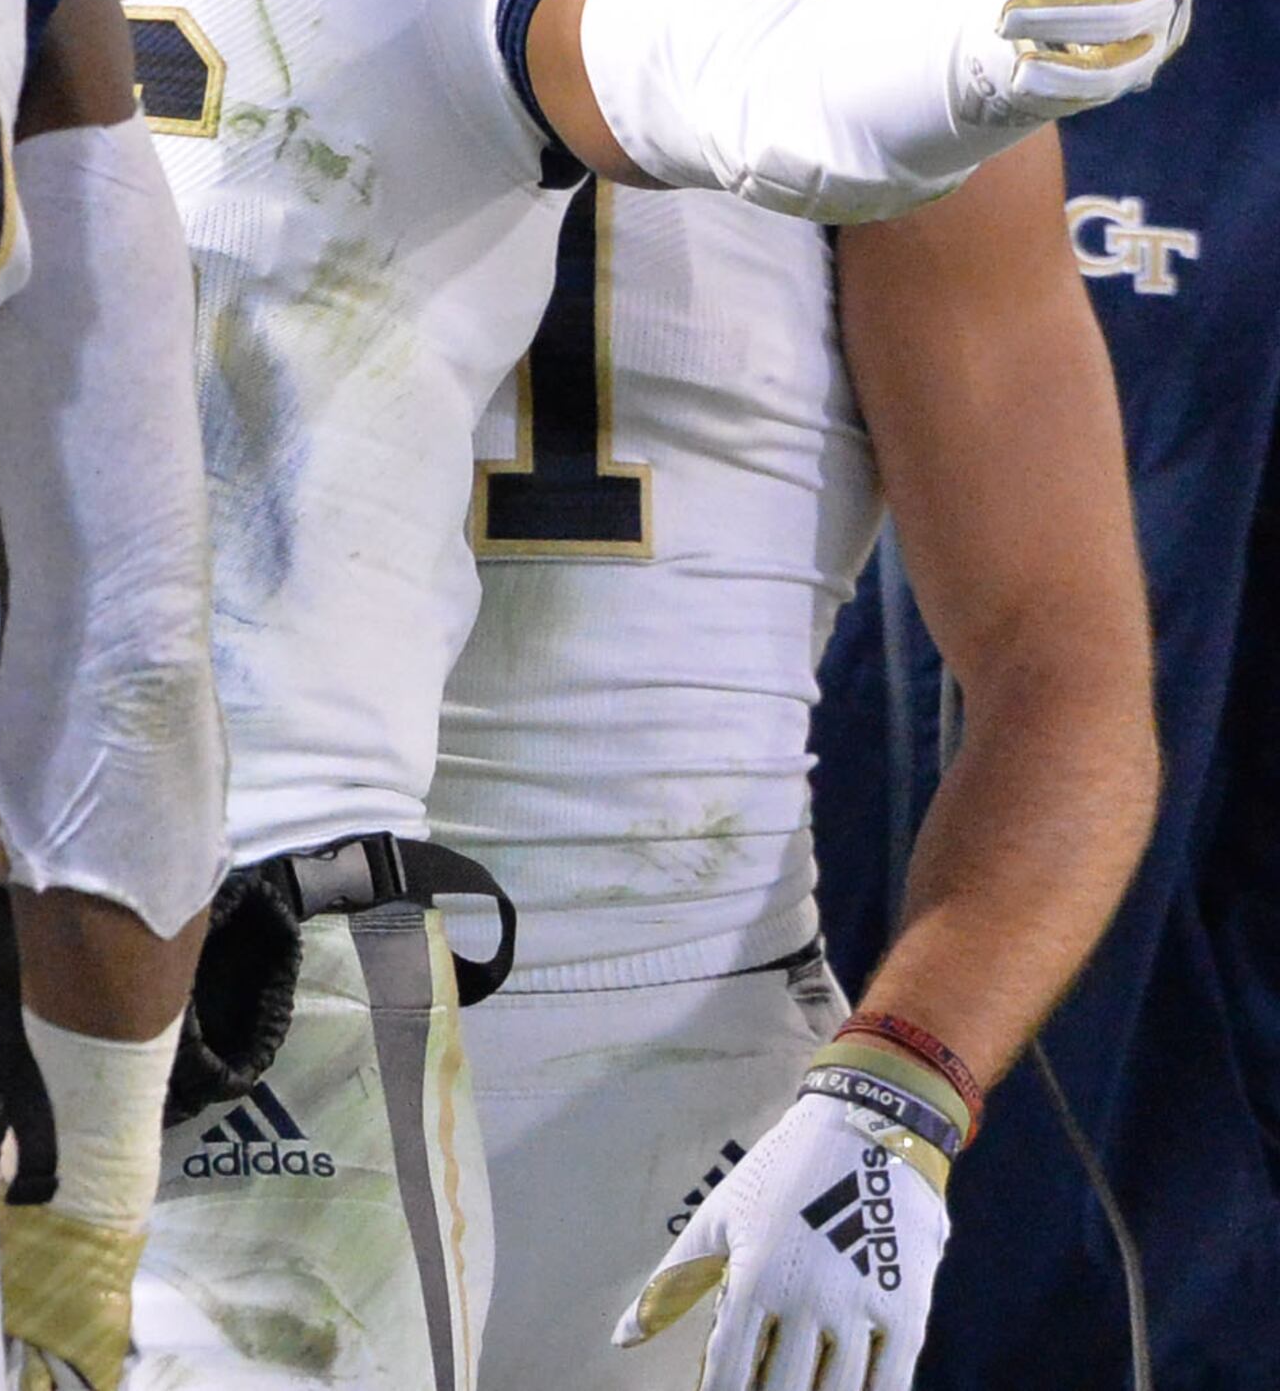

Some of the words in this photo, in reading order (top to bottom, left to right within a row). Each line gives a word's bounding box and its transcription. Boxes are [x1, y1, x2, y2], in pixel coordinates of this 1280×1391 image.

[855, 1082, 907, 1117] Love
[183, 1141, 336, 1179] adidas
[862, 1144, 902, 1292] adidas
